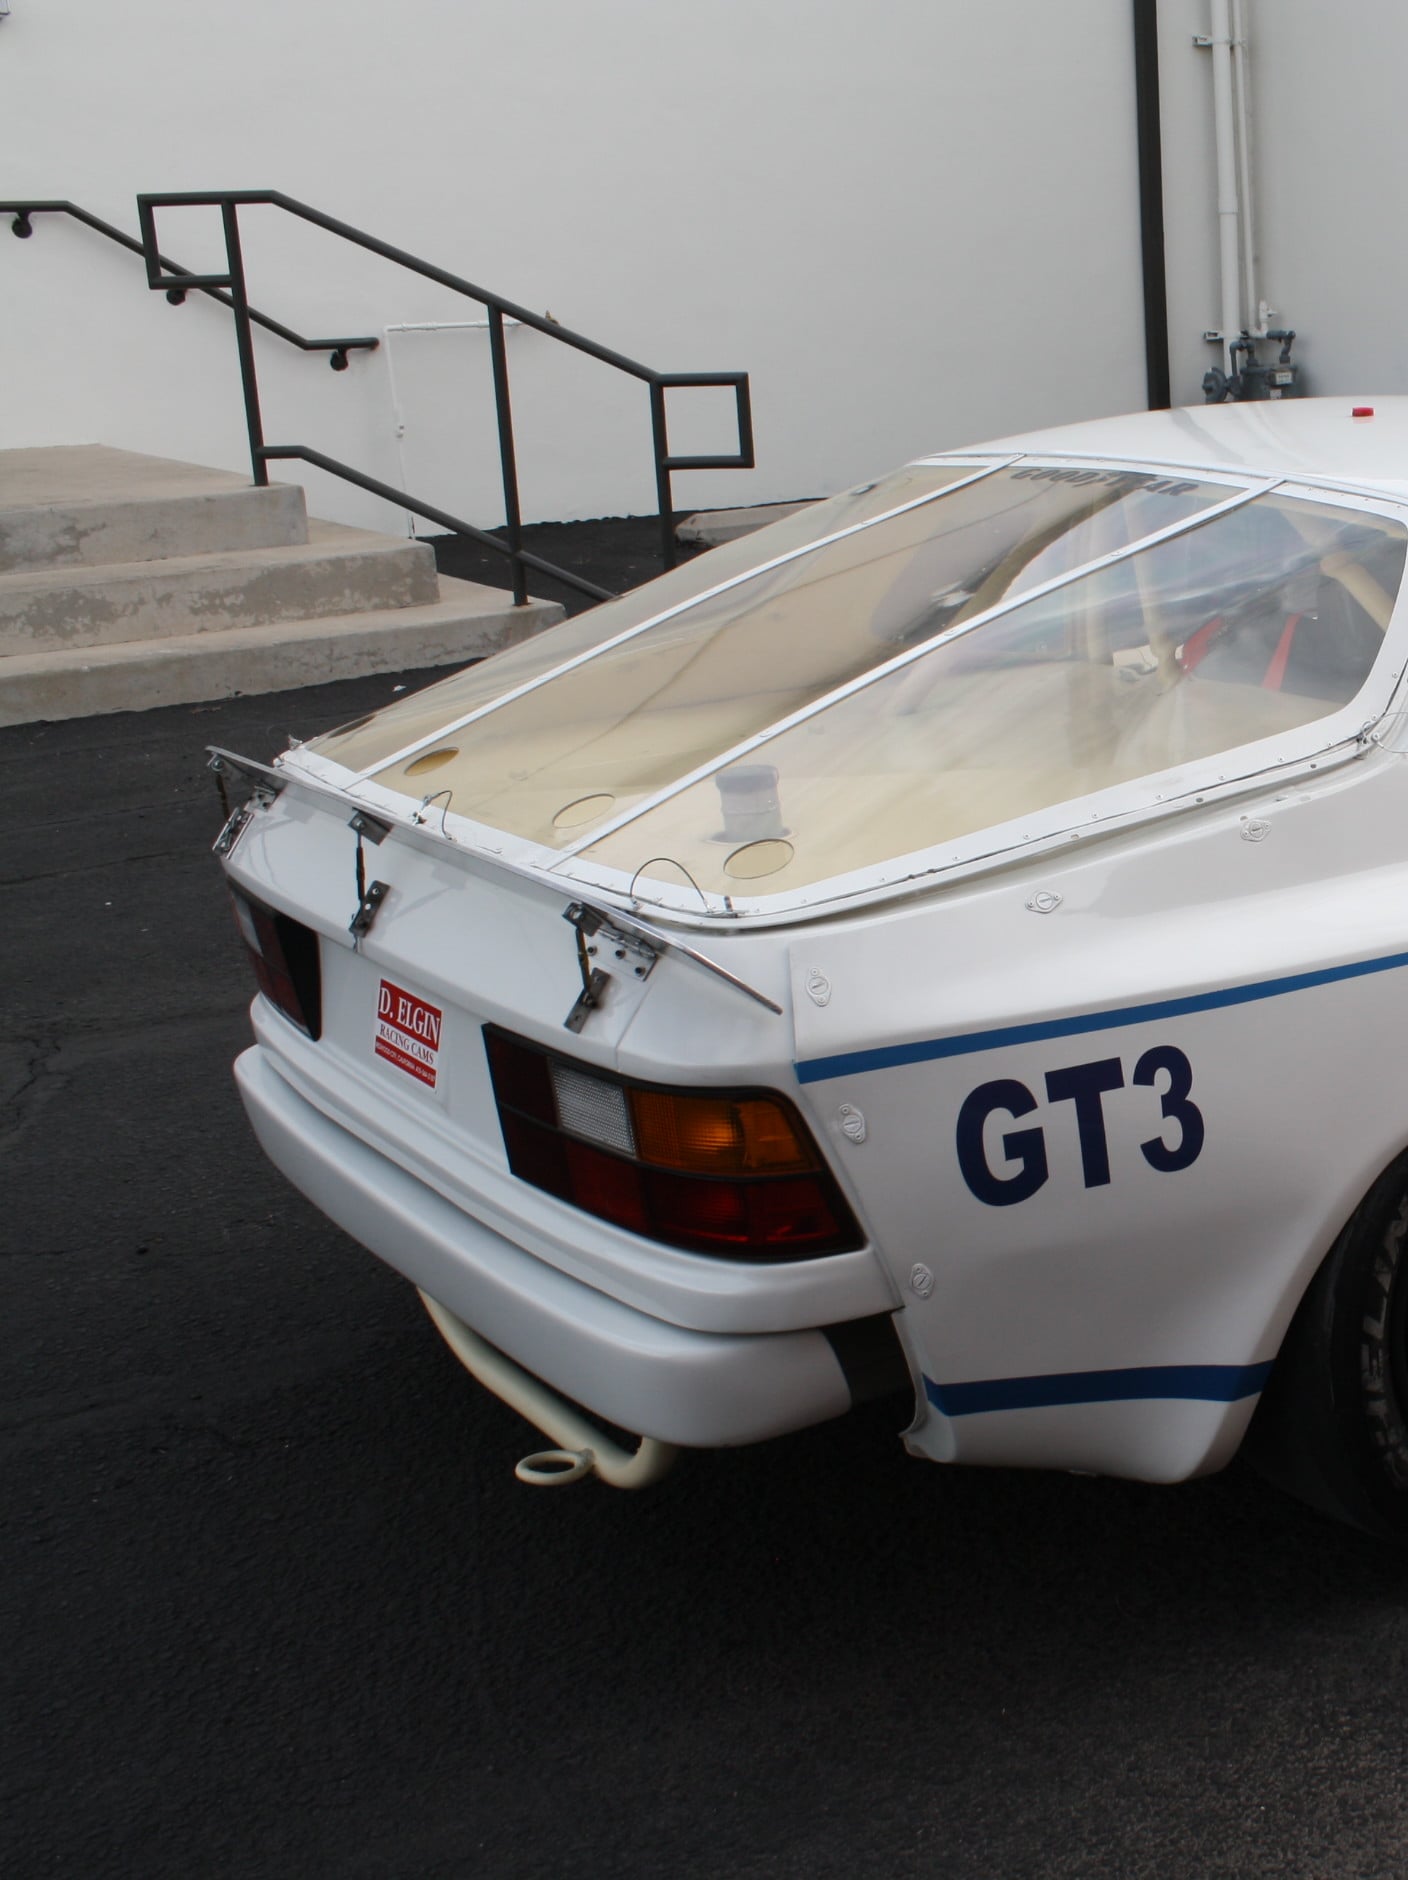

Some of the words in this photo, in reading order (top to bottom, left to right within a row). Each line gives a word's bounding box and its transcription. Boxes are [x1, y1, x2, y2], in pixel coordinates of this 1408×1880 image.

[379, 987, 394, 1019] D.
[397, 996, 440, 1045] ELGIN
[380, 1023, 410, 1051] RACING
[411, 1041, 434, 1065] CAMS
[956, 1045, 1205, 1207] GT3
